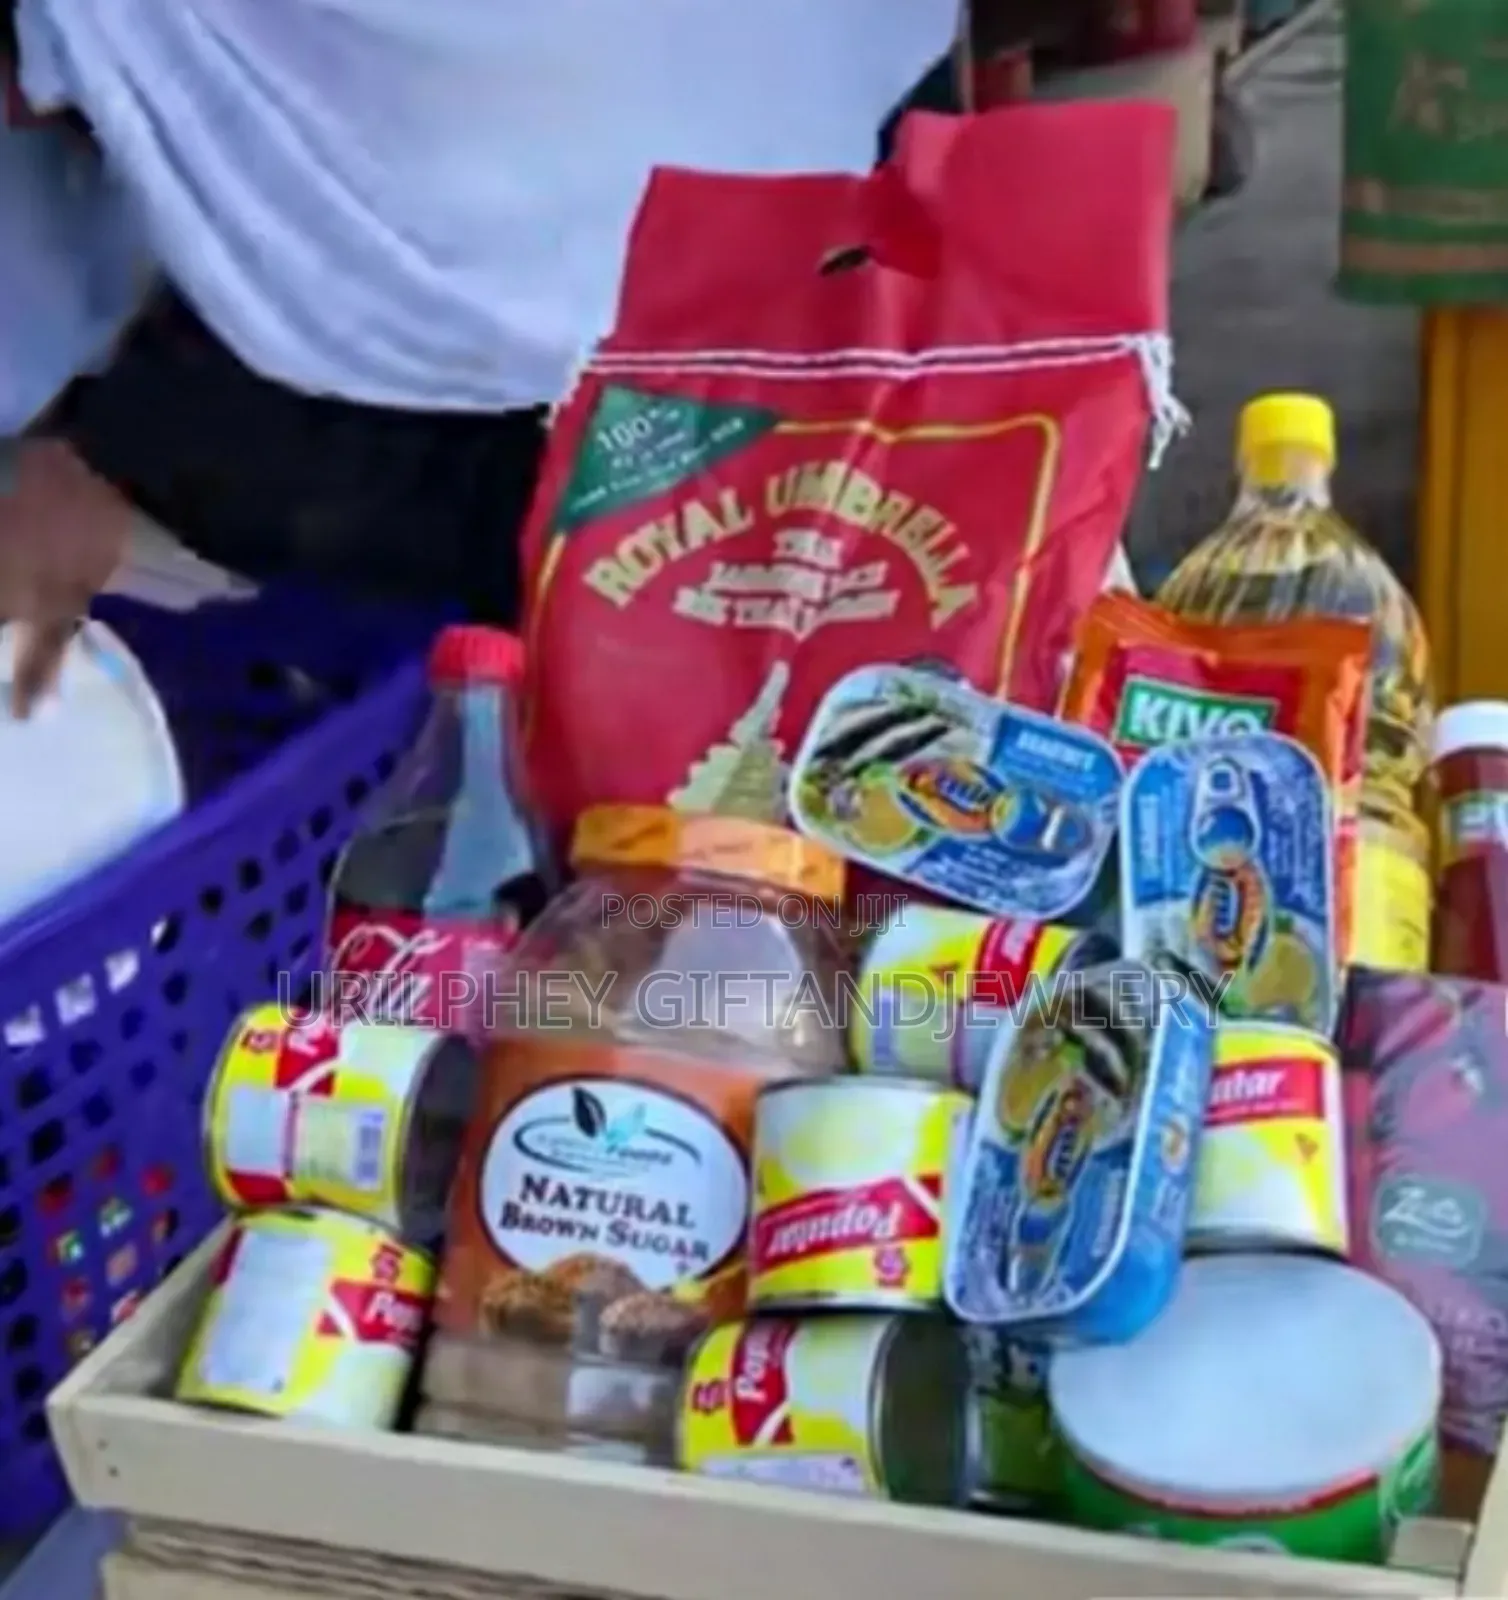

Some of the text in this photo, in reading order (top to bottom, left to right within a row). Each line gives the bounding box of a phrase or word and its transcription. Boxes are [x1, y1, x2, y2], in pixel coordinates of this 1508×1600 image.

[583, 460, 978, 630] ROYAL UMBRELLA
[499, 1201, 711, 1262] BROWN SUGAR
[519, 1173, 698, 1230] NATURAL
[765, 1199, 903, 1258] Popular
